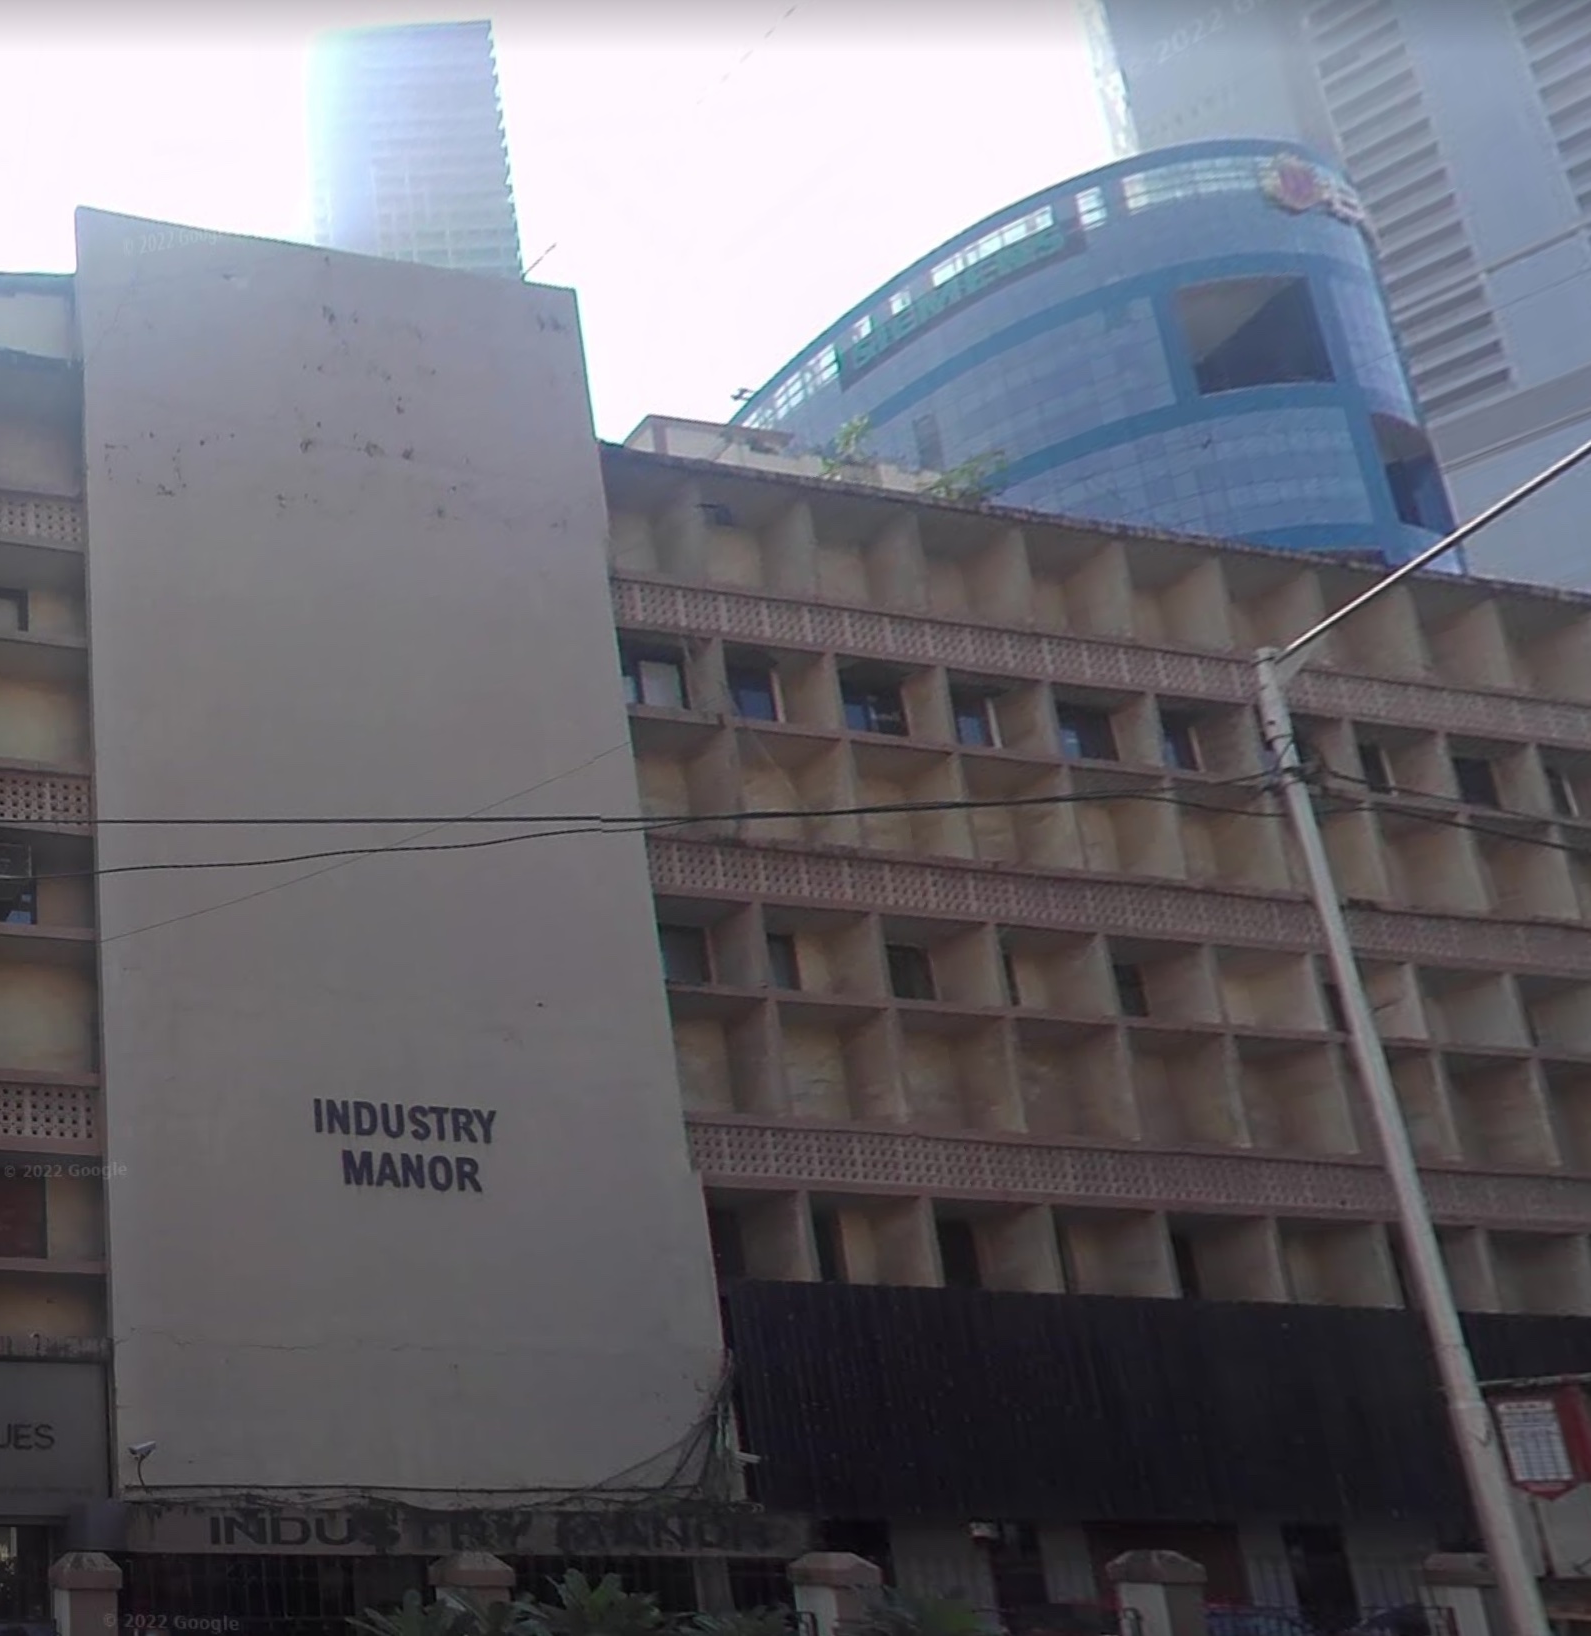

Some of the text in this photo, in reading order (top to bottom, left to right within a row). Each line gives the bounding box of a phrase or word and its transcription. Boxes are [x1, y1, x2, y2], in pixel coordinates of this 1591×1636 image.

[852, 228, 1065, 368] SIEMENS
[313, 1097, 497, 1143] INDUSTRY
[341, 1149, 483, 1192] MANOR
